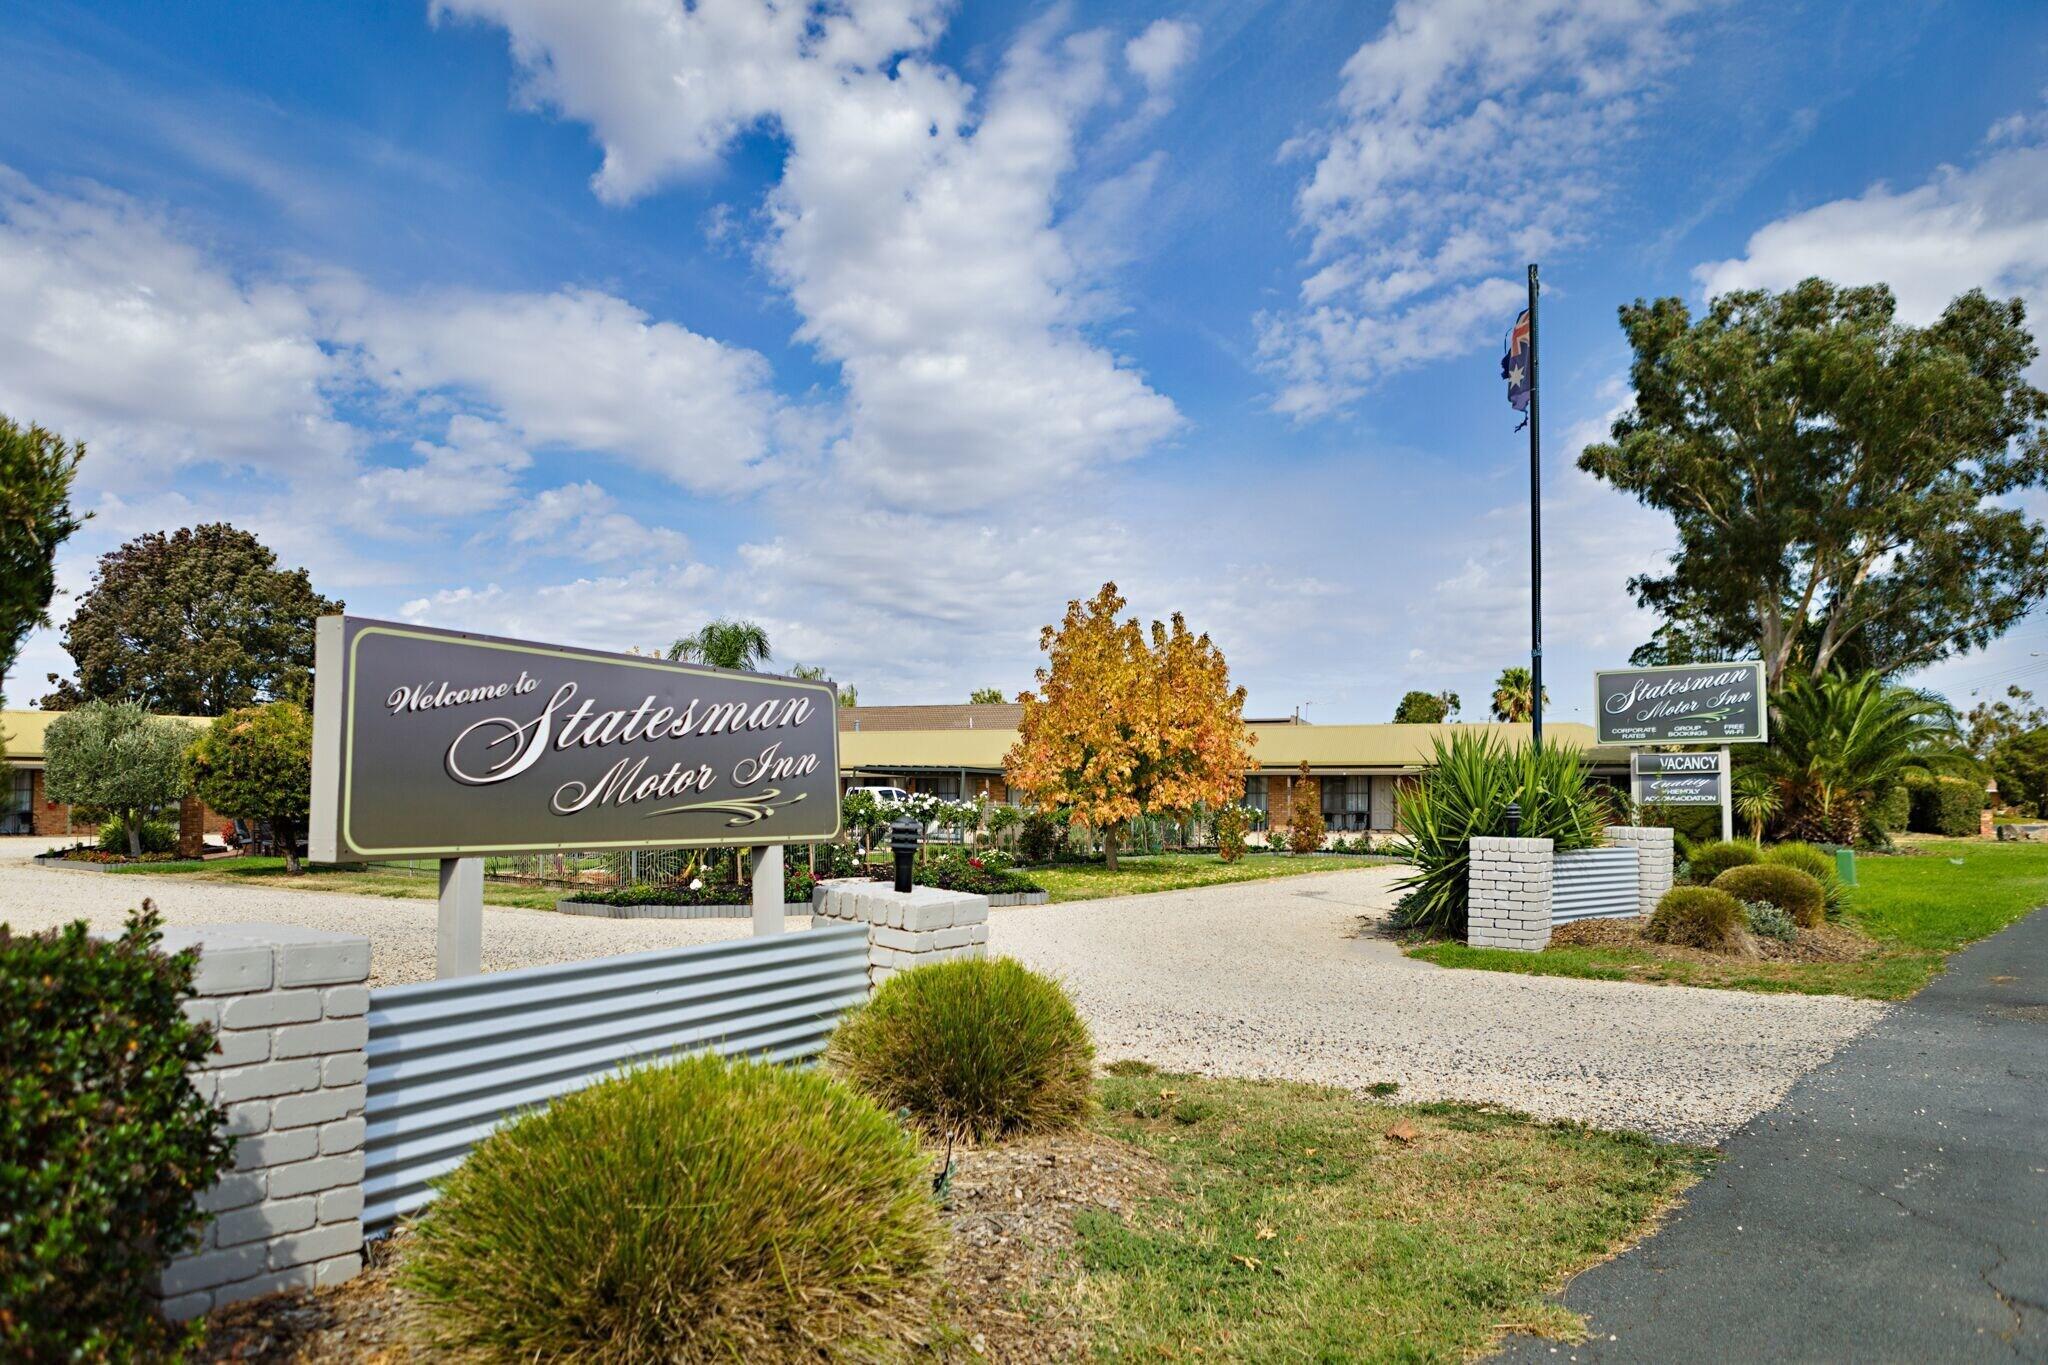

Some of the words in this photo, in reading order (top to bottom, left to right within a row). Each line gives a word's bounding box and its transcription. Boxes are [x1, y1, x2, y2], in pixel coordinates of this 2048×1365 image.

[387, 681, 512, 714] Welcome
[515, 670, 540, 695] to
[1605, 668, 1750, 714] Statesman
[1636, 700, 1700, 721] Motor
[1706, 689, 1752, 708] Inn
[449, 682, 815, 783] Statesman
[1611, 726, 1657, 734] CORPORATE
[1667, 730, 1708, 738] BOOKINGS
[553, 756, 717, 812] Motor
[733, 741, 820, 785] Inn
[1660, 756, 1717, 770] VACANCY
